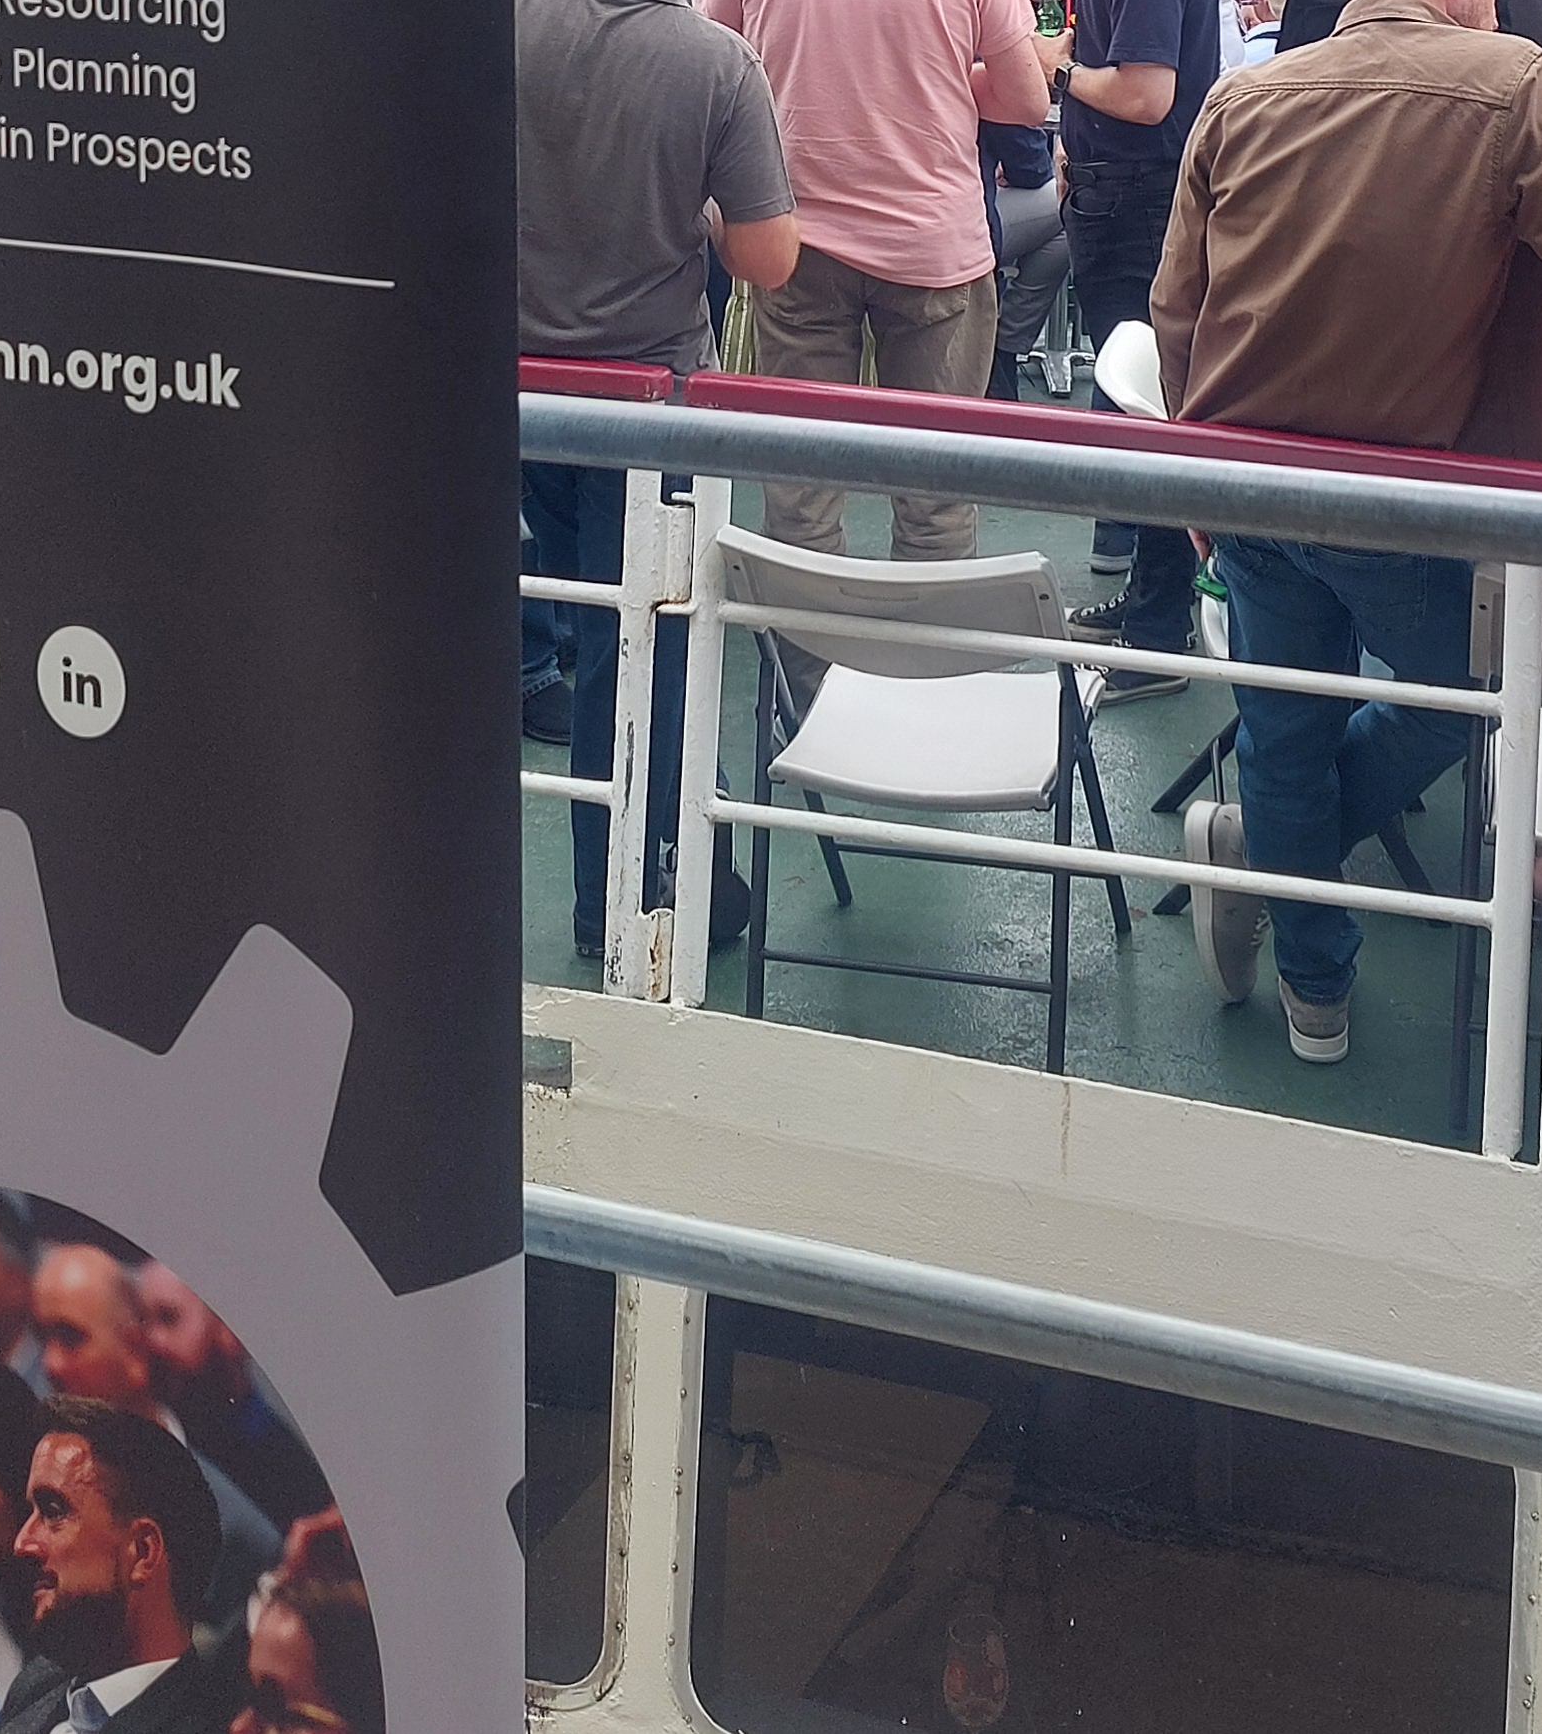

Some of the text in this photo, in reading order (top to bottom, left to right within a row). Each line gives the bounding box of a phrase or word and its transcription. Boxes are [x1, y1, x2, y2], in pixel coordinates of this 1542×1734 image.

[13, 47, 196, 114] Planning
[47, 122, 252, 183] Prospects
[61, 656, 103, 709] in
